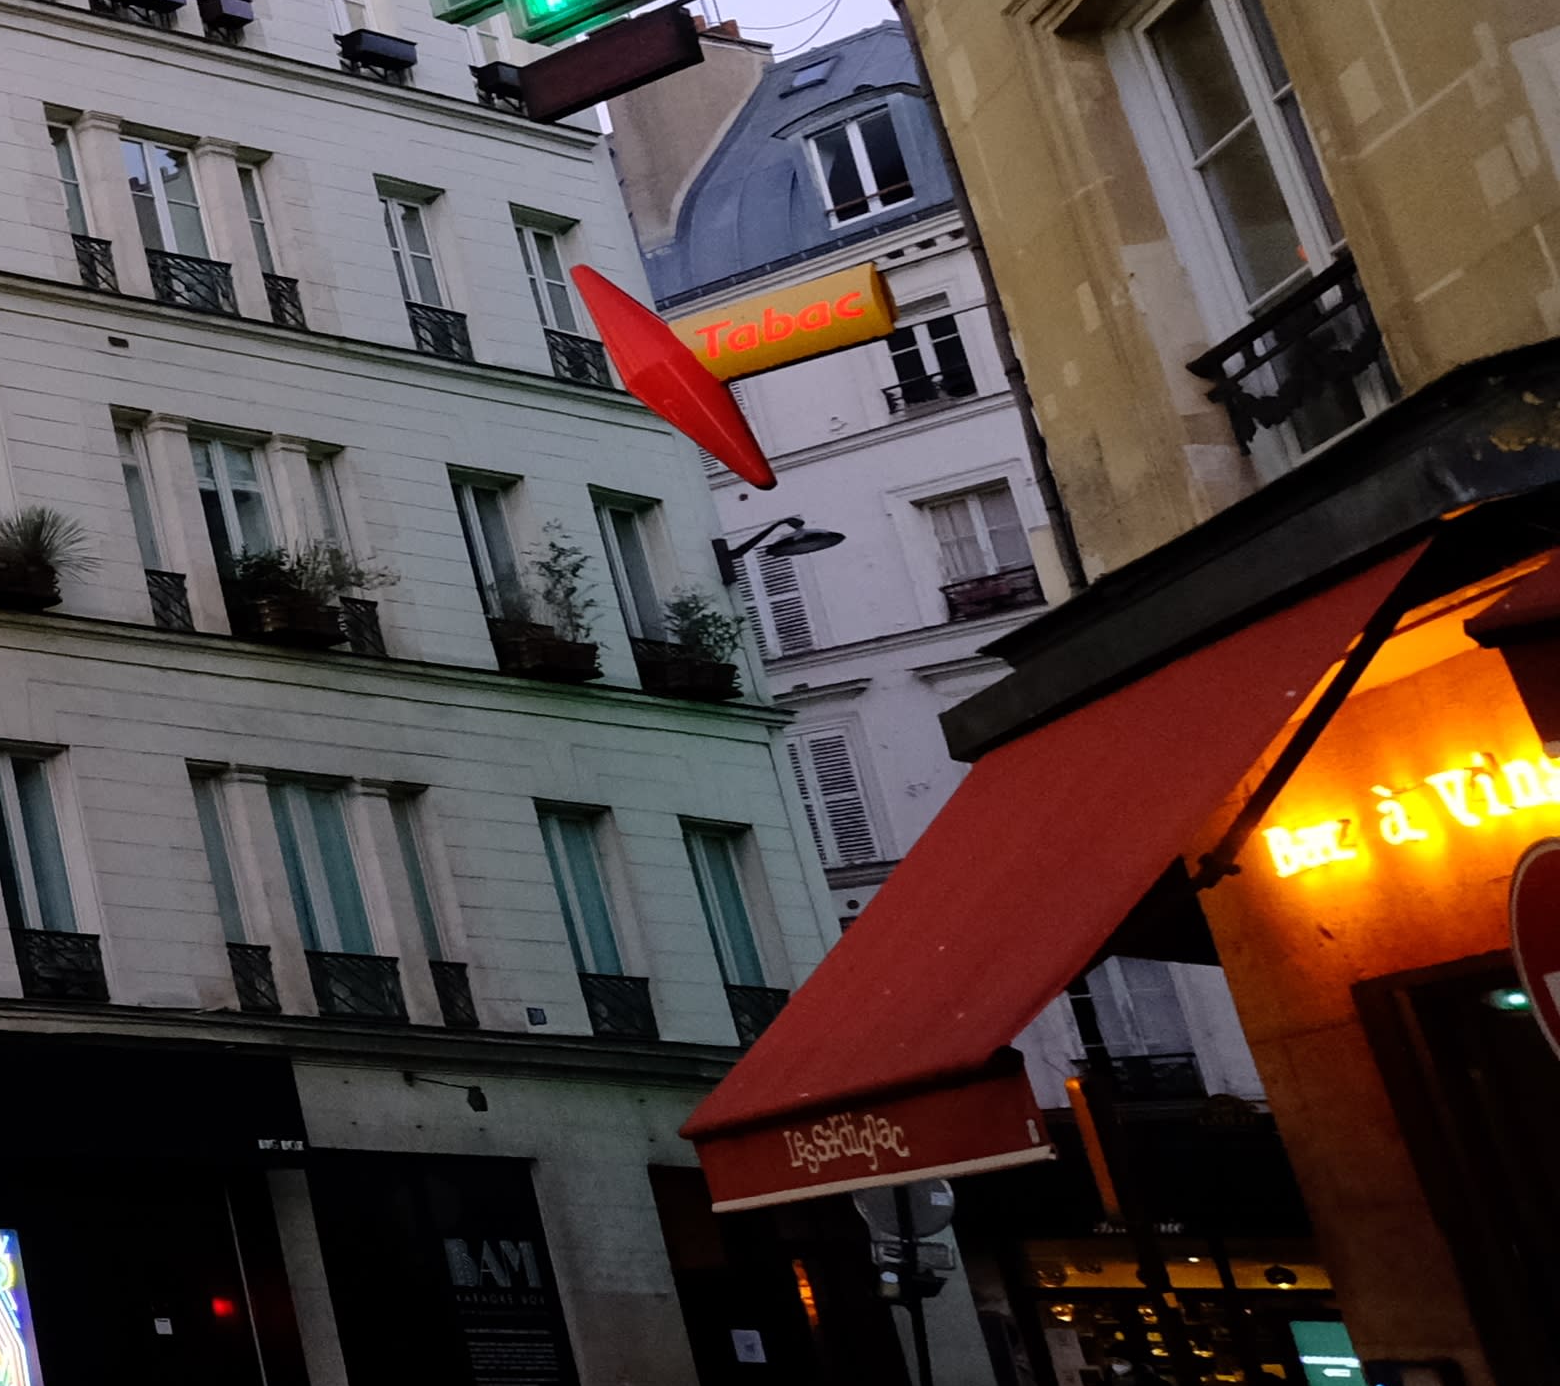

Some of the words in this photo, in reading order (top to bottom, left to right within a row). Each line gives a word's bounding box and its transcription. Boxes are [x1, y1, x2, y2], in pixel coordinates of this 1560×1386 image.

[695, 291, 865, 359] Tabac
[1262, 819, 1358, 878] Bar
[1371, 785, 1429, 845] à
[442, 1237, 544, 1289] BAM
